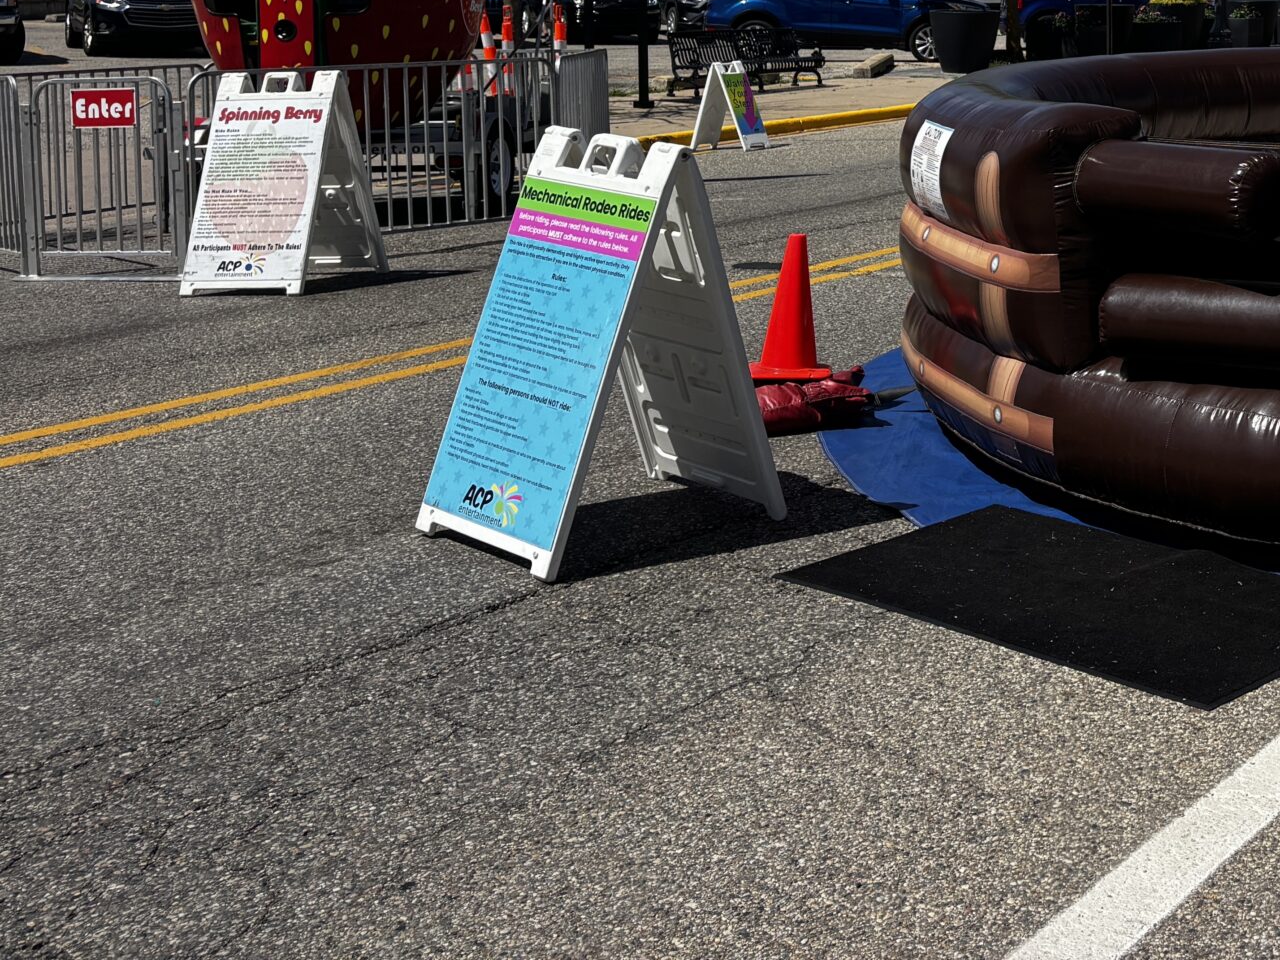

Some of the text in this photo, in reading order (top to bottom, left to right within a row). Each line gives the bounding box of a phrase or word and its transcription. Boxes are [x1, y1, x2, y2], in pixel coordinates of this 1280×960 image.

[76, 98, 132, 118] Enter
[219, 106, 323, 124] Spinning Berry
[521, 185, 650, 222] Mechanical Rodeo Rides
[200, 244, 231, 252] Participants
[248, 243, 266, 251] Adhere
[267, 243, 274, 251] To
[217, 260, 242, 272] ACP
[551, 273, 567, 282] Rules:
[478, 377, 487, 386] The
[487, 380, 510, 395] following
[508, 388, 529, 399] persons
[529, 394, 548, 405] should
[548, 398, 559, 408] NOT
[558, 402, 572, 412] ride:
[463, 484, 494, 511] ACP
[458, 505, 501, 527] entertainment
